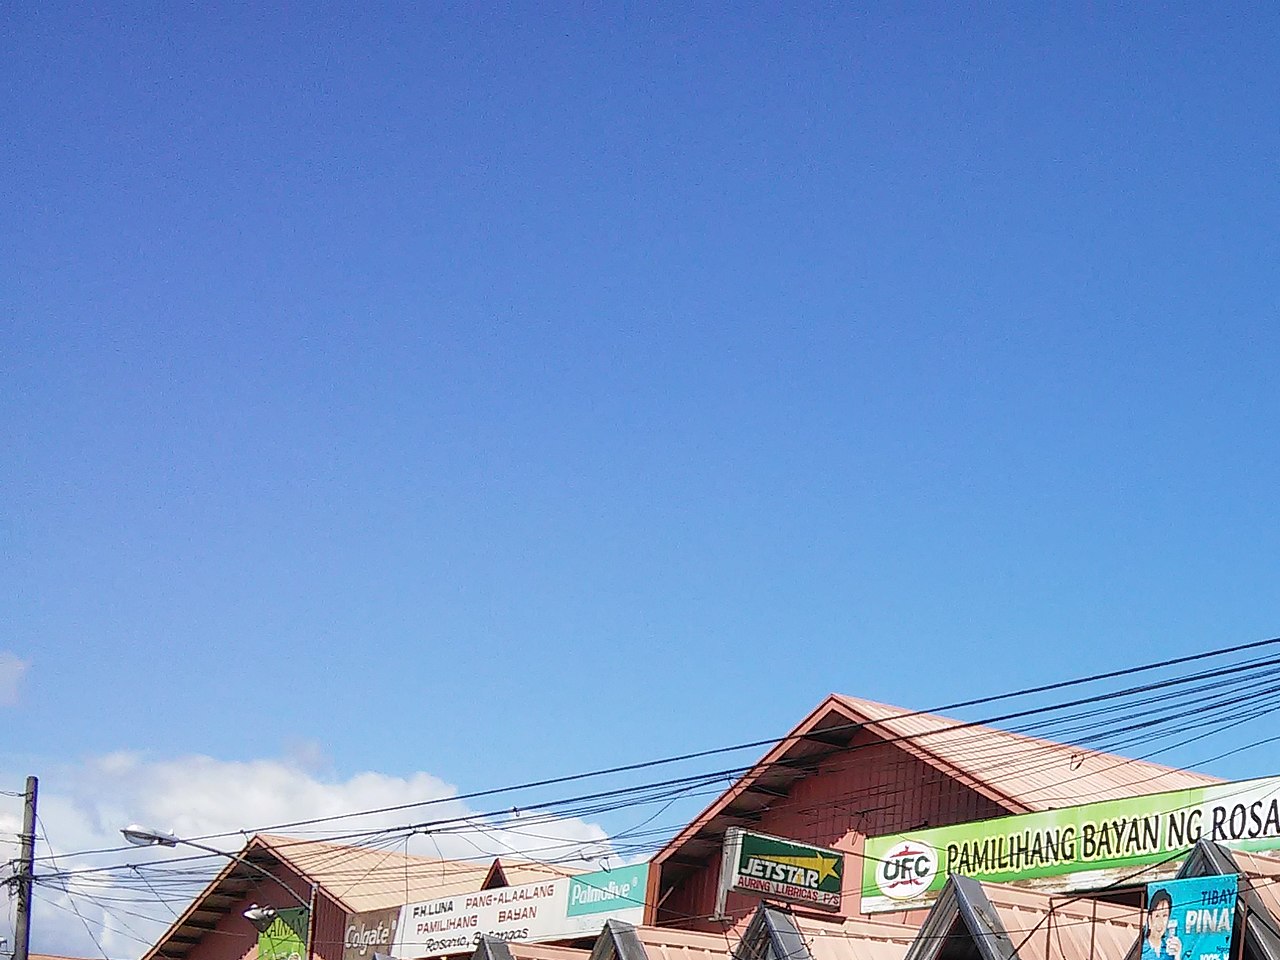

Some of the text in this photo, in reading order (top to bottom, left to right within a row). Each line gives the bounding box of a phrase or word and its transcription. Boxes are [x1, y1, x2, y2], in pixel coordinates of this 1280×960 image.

[946, 828, 1076, 874] PAMILIHANG
[1082, 812, 1162, 860] BAYAN
[1168, 809, 1203, 847] NG
[741, 858, 819, 888] JETSTAR
[883, 855, 931, 880] UFC
[465, 884, 555, 909] PANG-ALAALANG
[571, 880, 632, 907] Palmolive
[738, 875, 840, 905] AURING LUBRICAS F/S
[1201, 888, 1236, 906] TIBAY
[416, 906, 537, 936] PAMILIHANG BAYAN
[1184, 907, 1235, 934] PINA
[345, 922, 391, 956] Colgate
